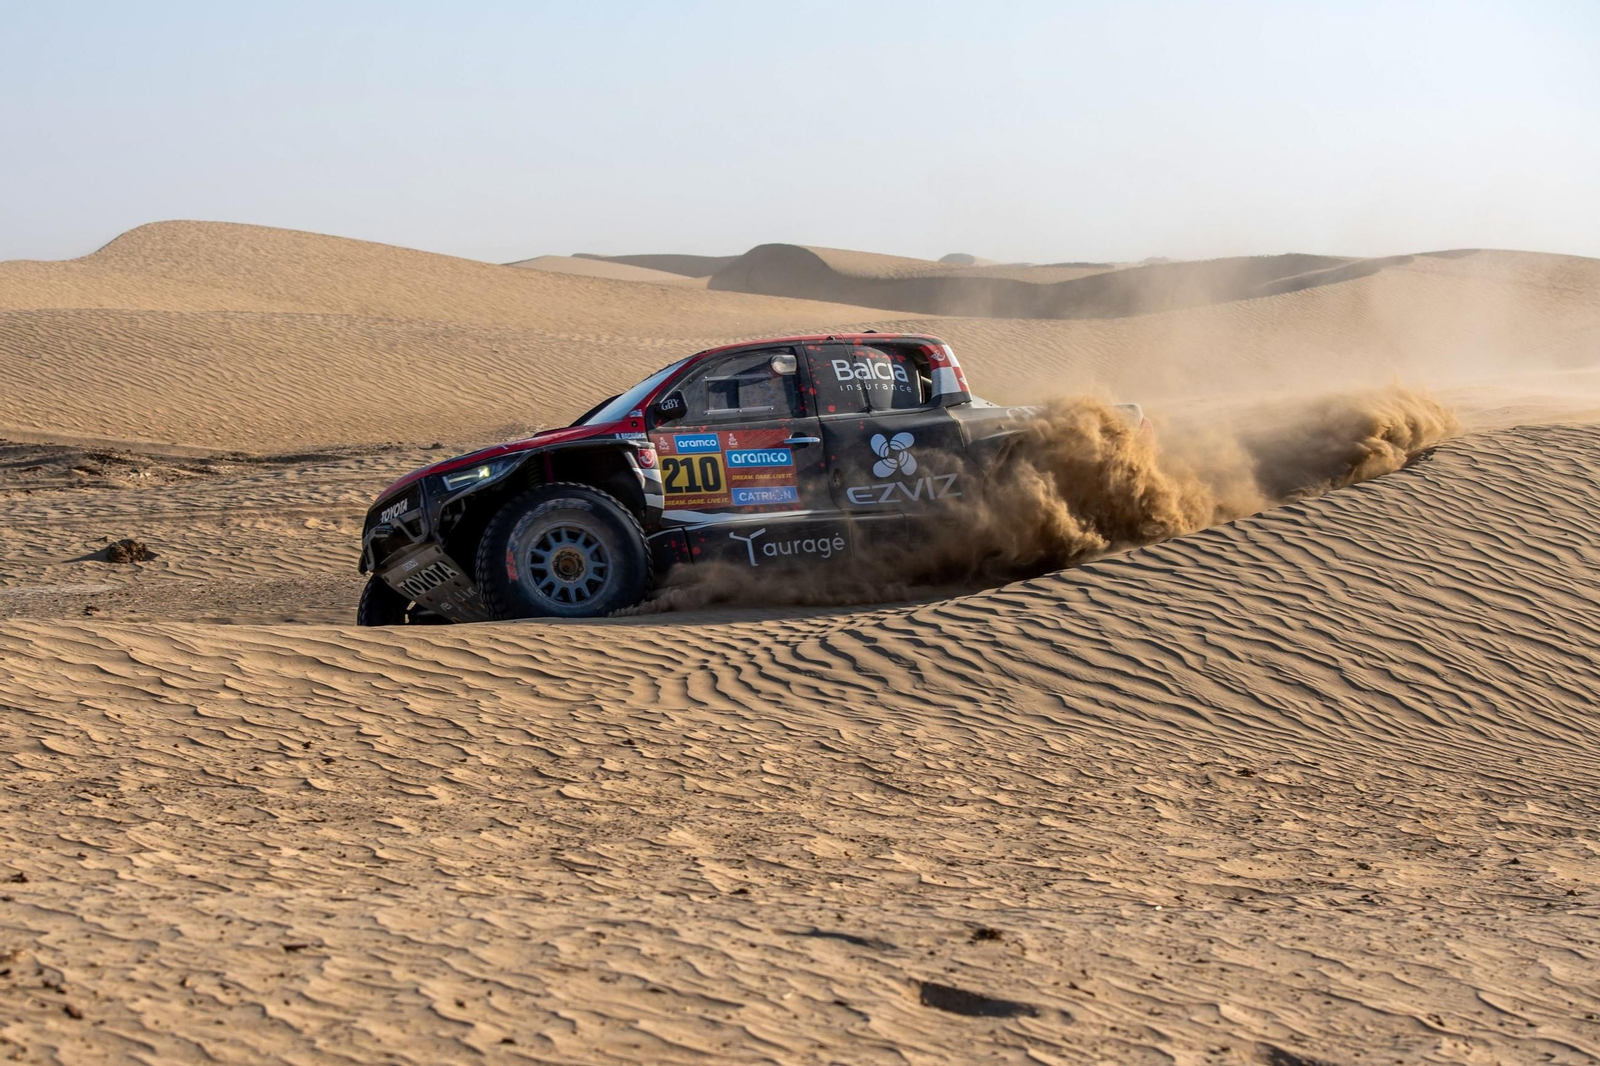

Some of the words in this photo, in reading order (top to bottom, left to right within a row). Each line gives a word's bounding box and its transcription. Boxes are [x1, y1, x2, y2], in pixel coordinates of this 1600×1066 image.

[831, 358, 909, 383] Balcia
[839, 383, 912, 393] insurance
[661, 398, 679, 411] GBY
[678, 438, 717, 448] aramco
[731, 452, 788, 464] aramco
[662, 456, 722, 494] 210
[846, 473, 963, 505] EZVIZ
[381, 498, 408, 523] TOYOTA
[397, 561, 459, 599] TOYOTA
